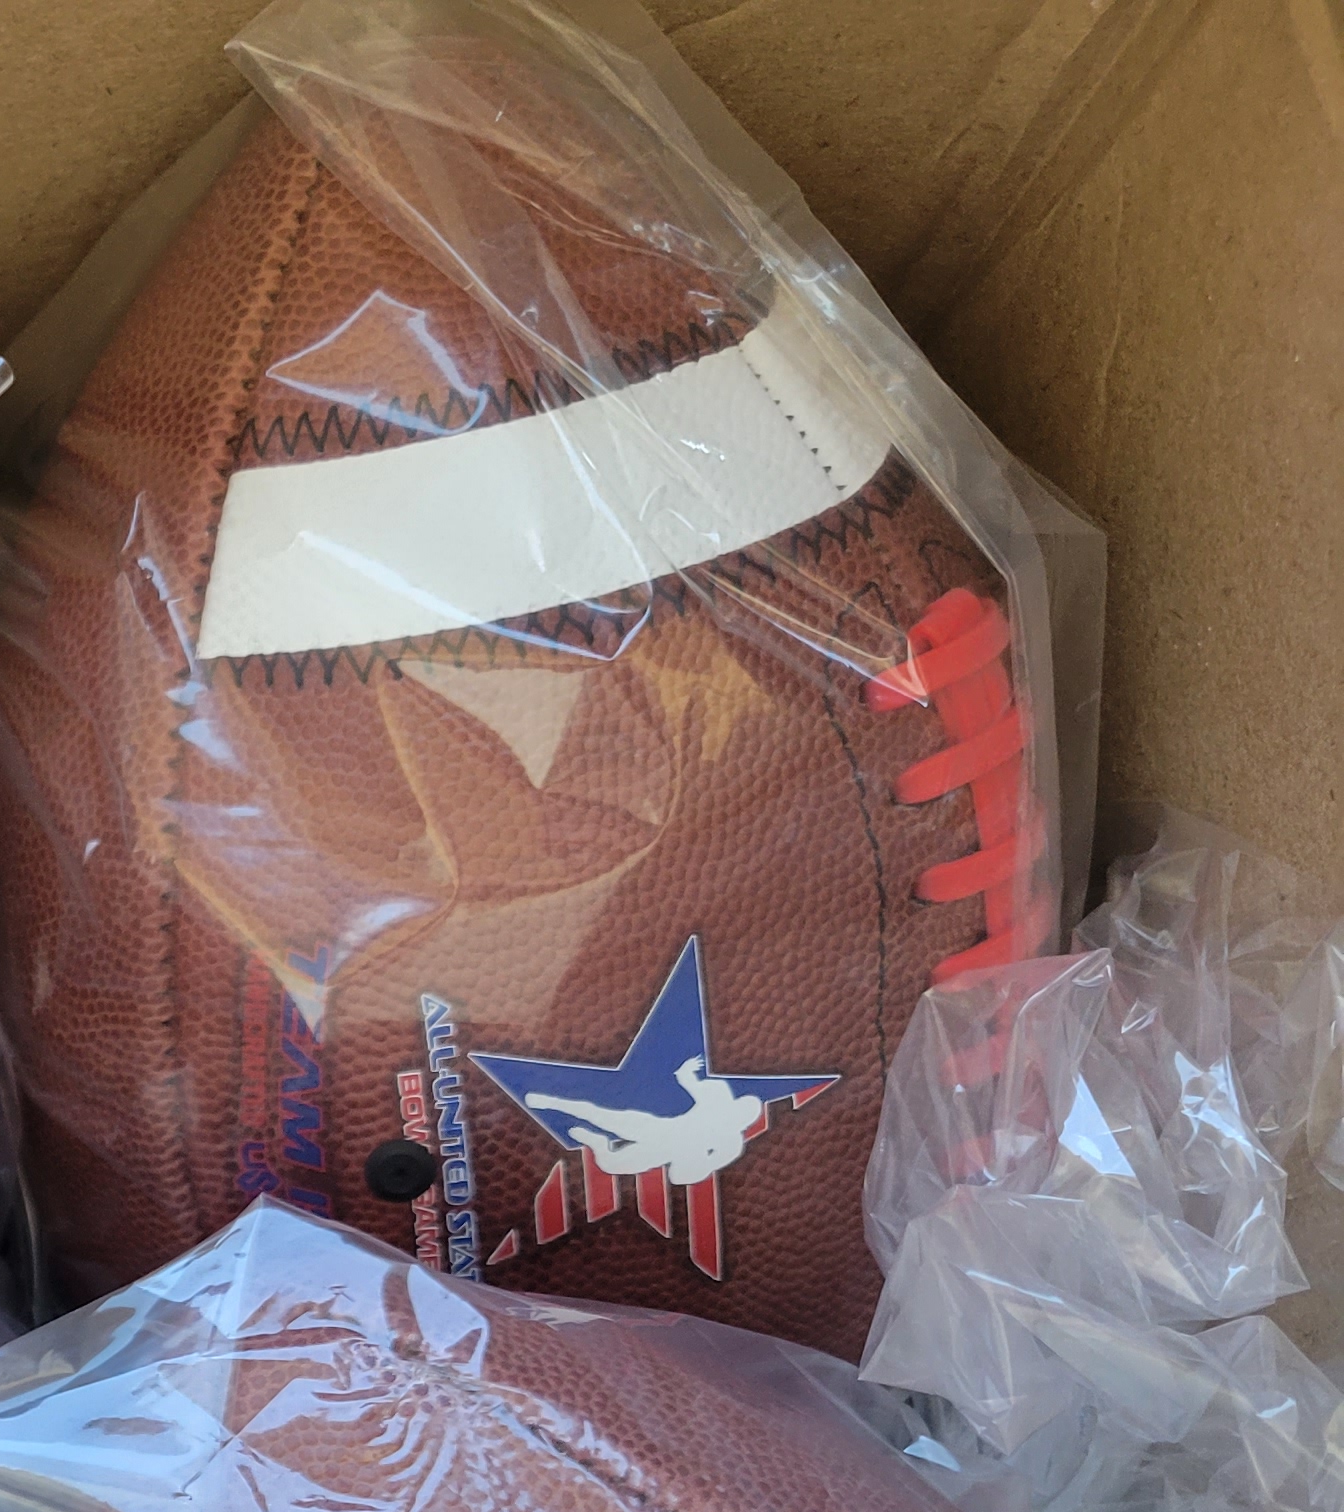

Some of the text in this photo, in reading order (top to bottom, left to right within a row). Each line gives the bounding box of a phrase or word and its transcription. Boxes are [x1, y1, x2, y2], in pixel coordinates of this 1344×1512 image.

[398, 1071, 431, 1154] BOW
[421, 993, 480, 1282] ALL-UNITED STAT
[235, 1142, 281, 1197] US
